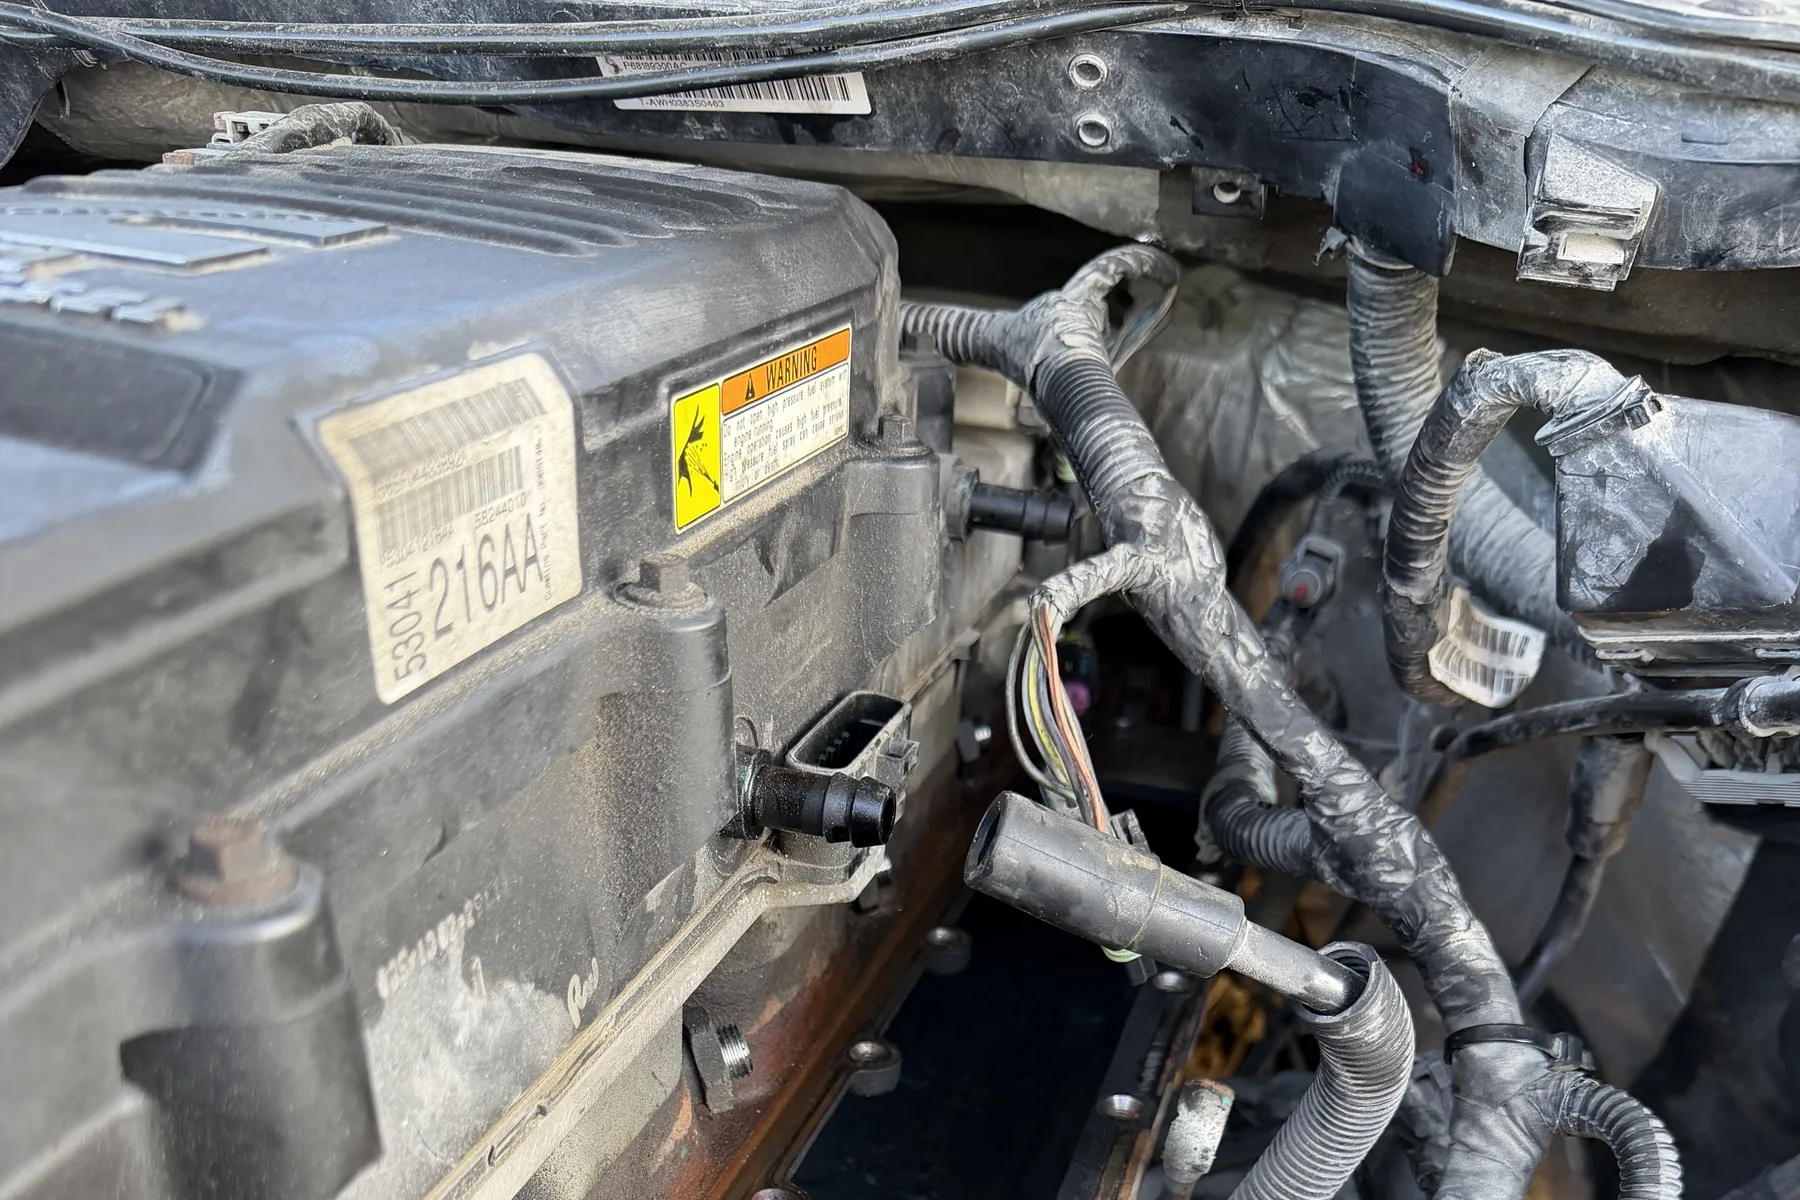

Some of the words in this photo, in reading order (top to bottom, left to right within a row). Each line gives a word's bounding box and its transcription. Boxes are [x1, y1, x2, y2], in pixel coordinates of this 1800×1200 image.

[765, 345, 817, 392] WARNING
[723, 423, 731, 438] Do
[736, 416, 745, 431] not
[750, 410, 763, 427] open
[767, 400, 778, 417] high
[783, 390, 803, 412] pressure
[808, 381, 817, 397] fuel
[820, 375, 836, 393] system
[776, 422, 793, 440] causes
[811, 405, 820, 421] fuel
[800, 428, 809, 441] can
[812, 420, 825, 435] cause
[475, 492, 527, 530] 58244010
[540, 521, 548, 550] Part
[383, 570, 427, 682] 53041
[429, 512, 544, 640] 216AA
